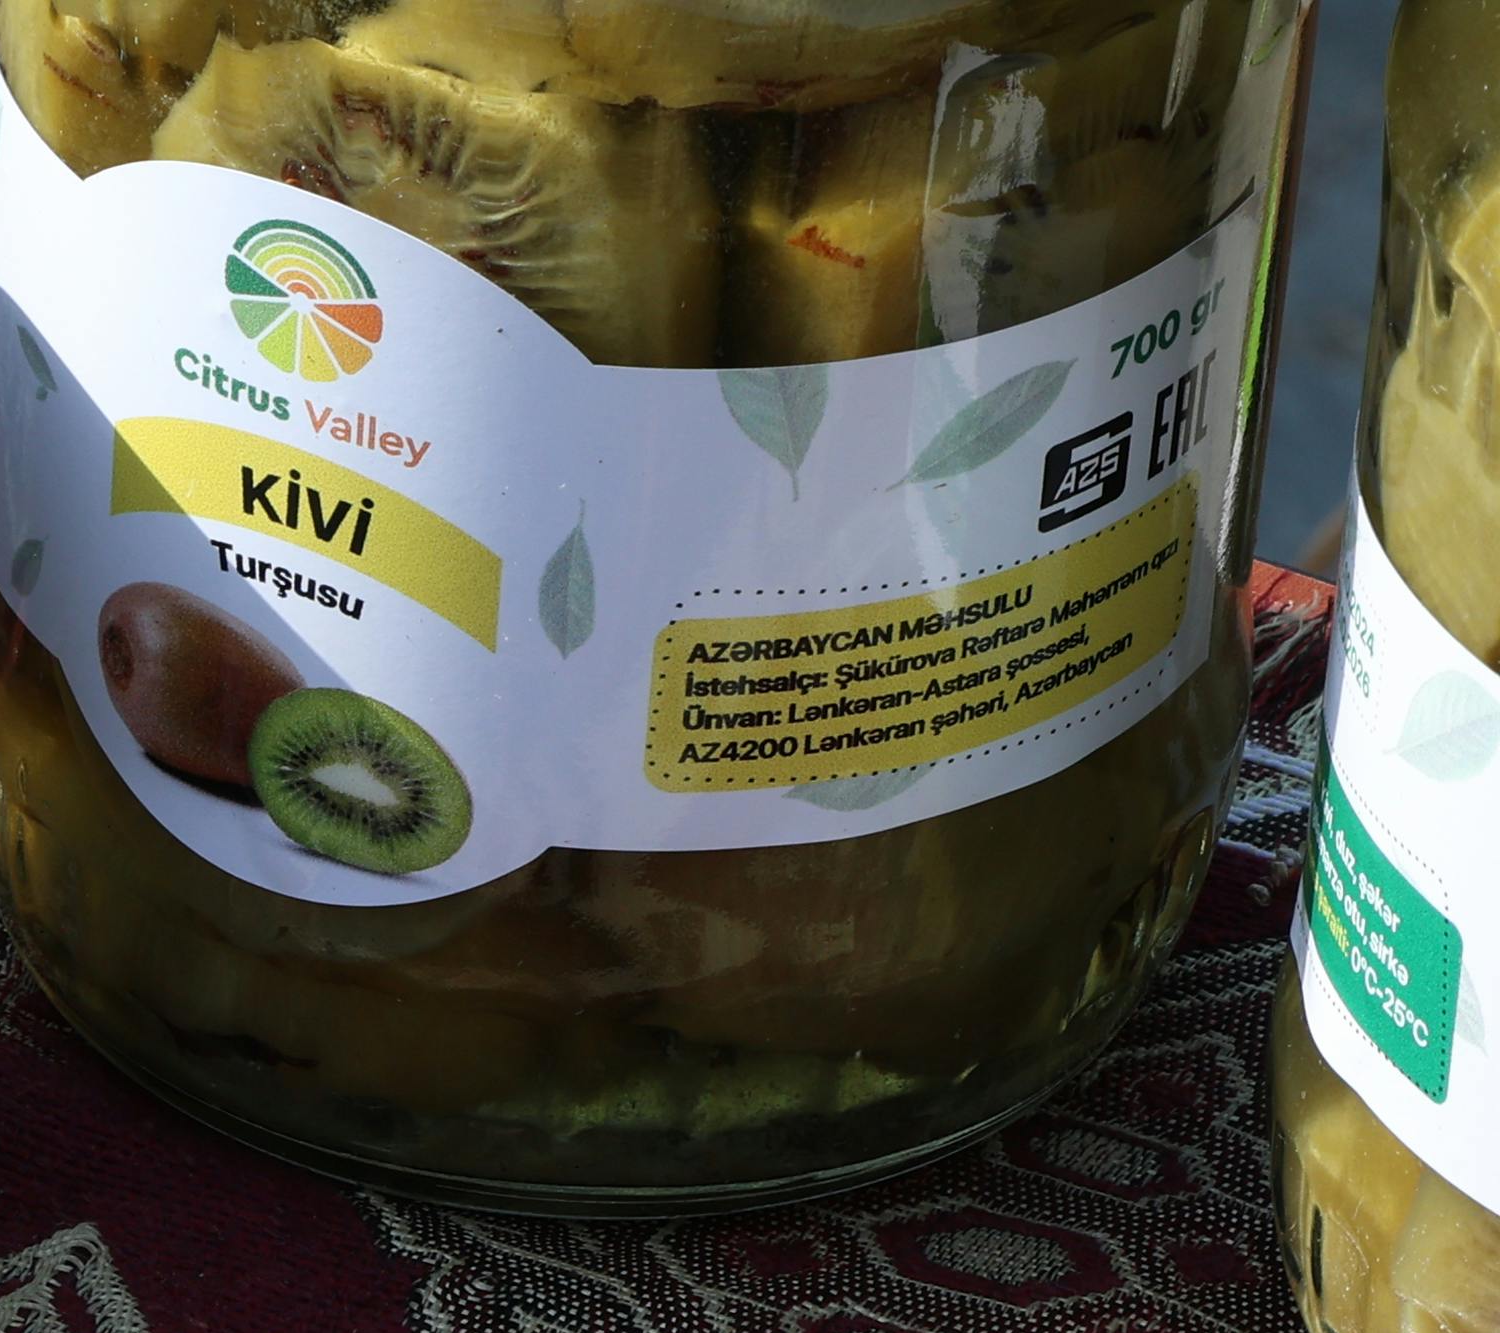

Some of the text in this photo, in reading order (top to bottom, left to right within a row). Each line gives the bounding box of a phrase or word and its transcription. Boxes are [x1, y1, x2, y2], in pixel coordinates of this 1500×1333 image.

[1110, 277, 1226, 380] 700 gr
[174, 347, 432, 469] Citrus Valley
[1148, 348, 1218, 481] EAC
[210, 539, 365, 620] Turşusu
[685, 670, 828, 697] İstehsalçı:
[833, 646, 956, 690] Şükürova
[961, 616, 1046, 659] Rəftarə
[1050, 561, 1149, 628] Məhərrəm
[687, 584, 1033, 664] AZƏRBAYCAN MƏHSULU
[678, 632, 1134, 764] AZ4200 Lənkəran şəhəri, Azərbaycan
[682, 622, 1090, 731] Ünvan: Lənkəran-Astara şossesi,
